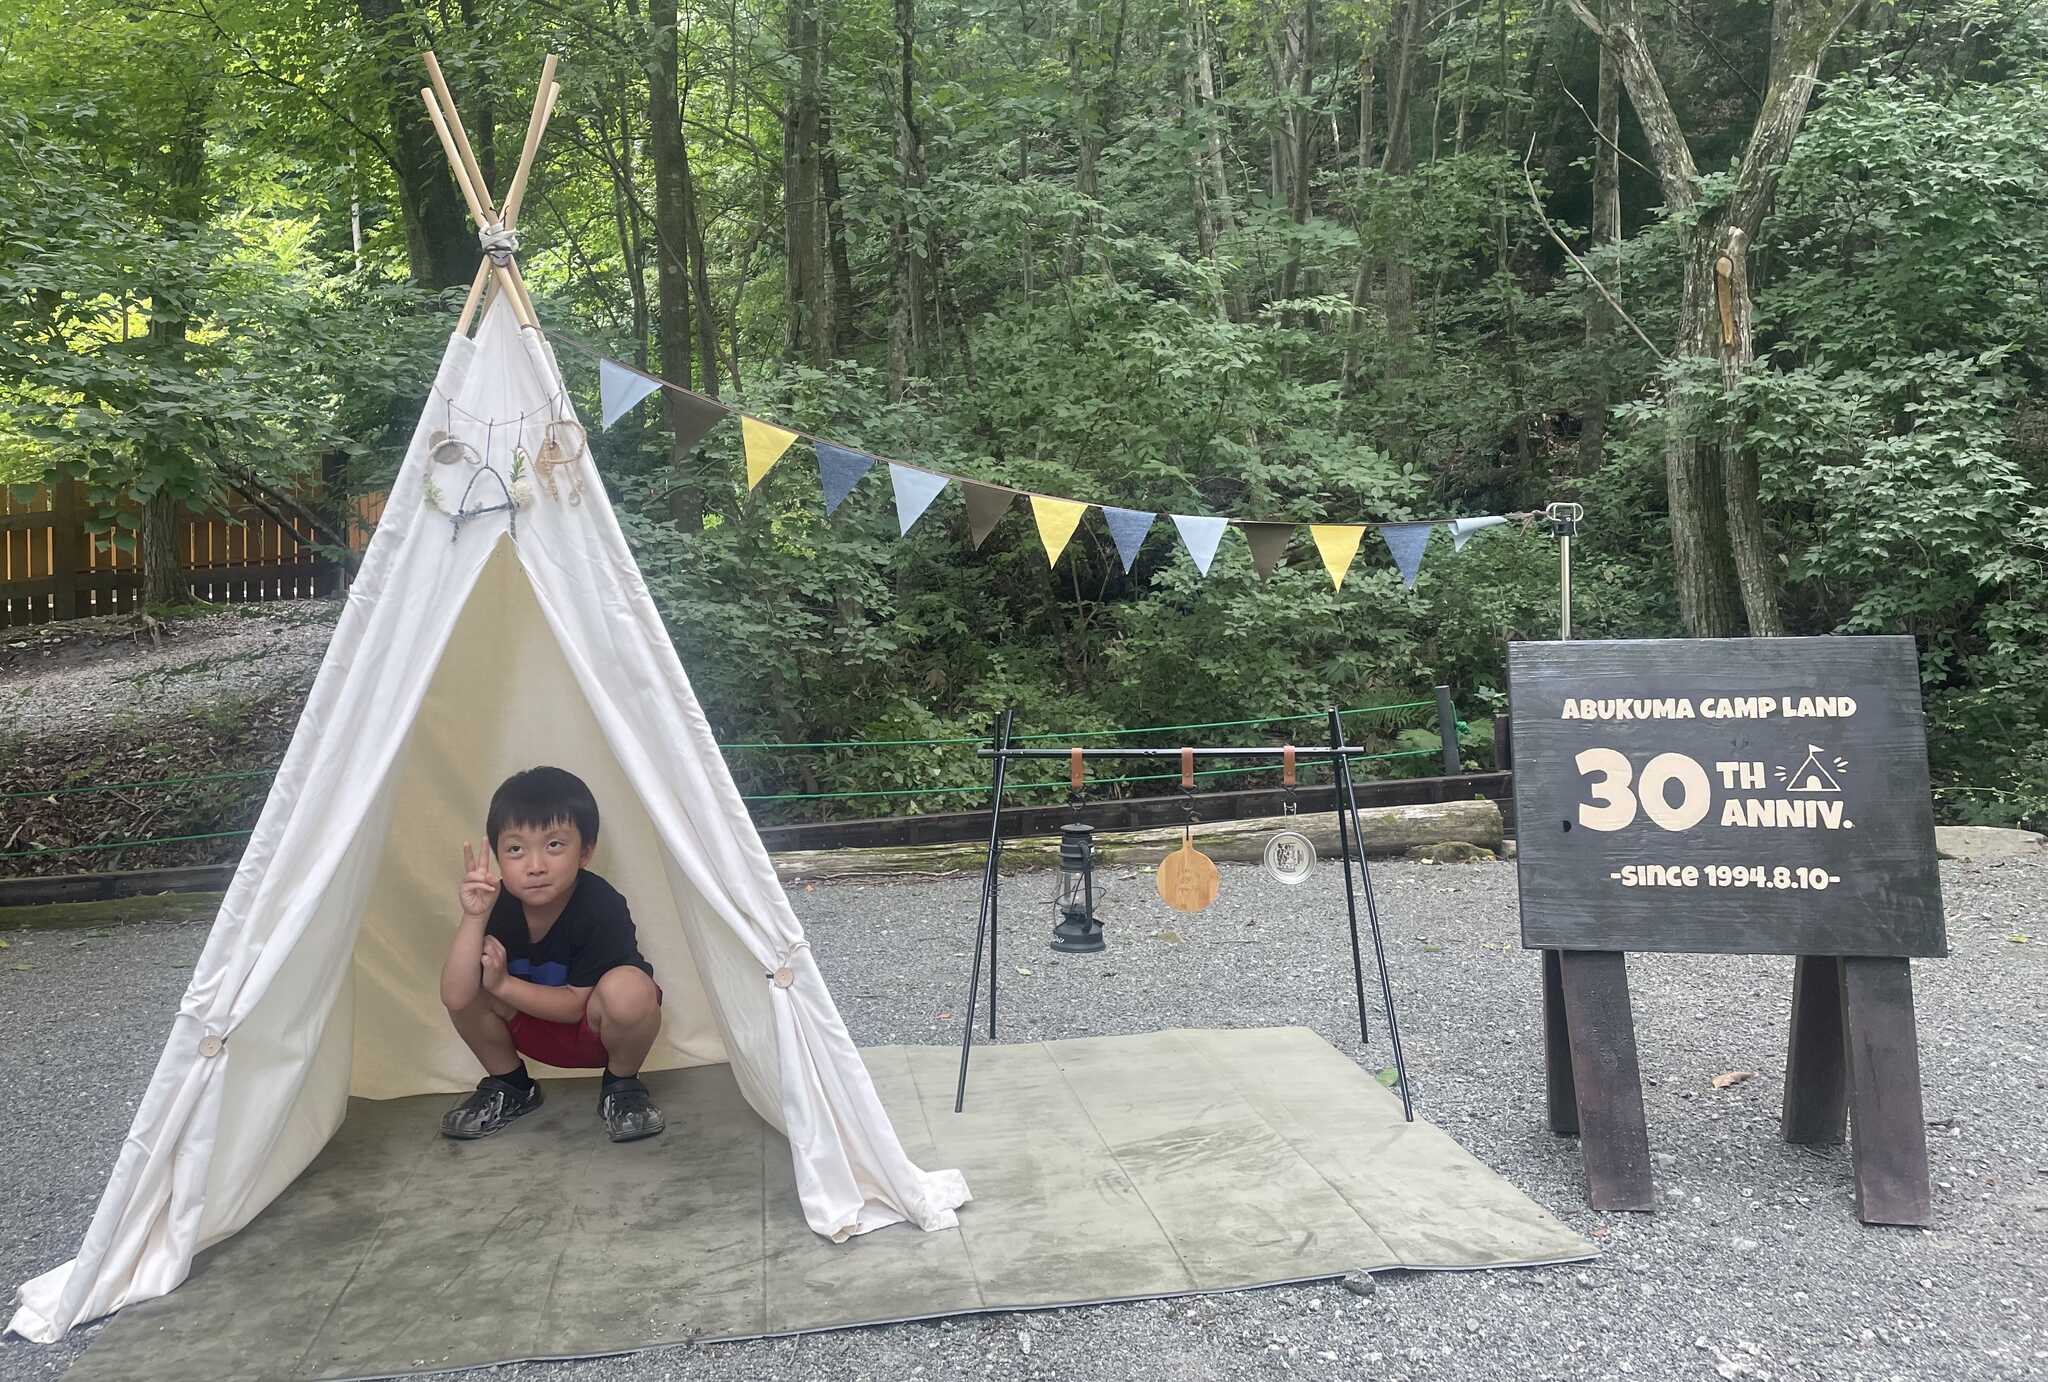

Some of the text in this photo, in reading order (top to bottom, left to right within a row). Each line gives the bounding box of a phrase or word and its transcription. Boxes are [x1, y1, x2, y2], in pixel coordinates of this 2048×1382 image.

[1561, 696, 1857, 721] ABUKUMA CAMP LAND
[1574, 747, 1767, 832] 30 TH
[1720, 799, 1856, 830] ANNIV.
